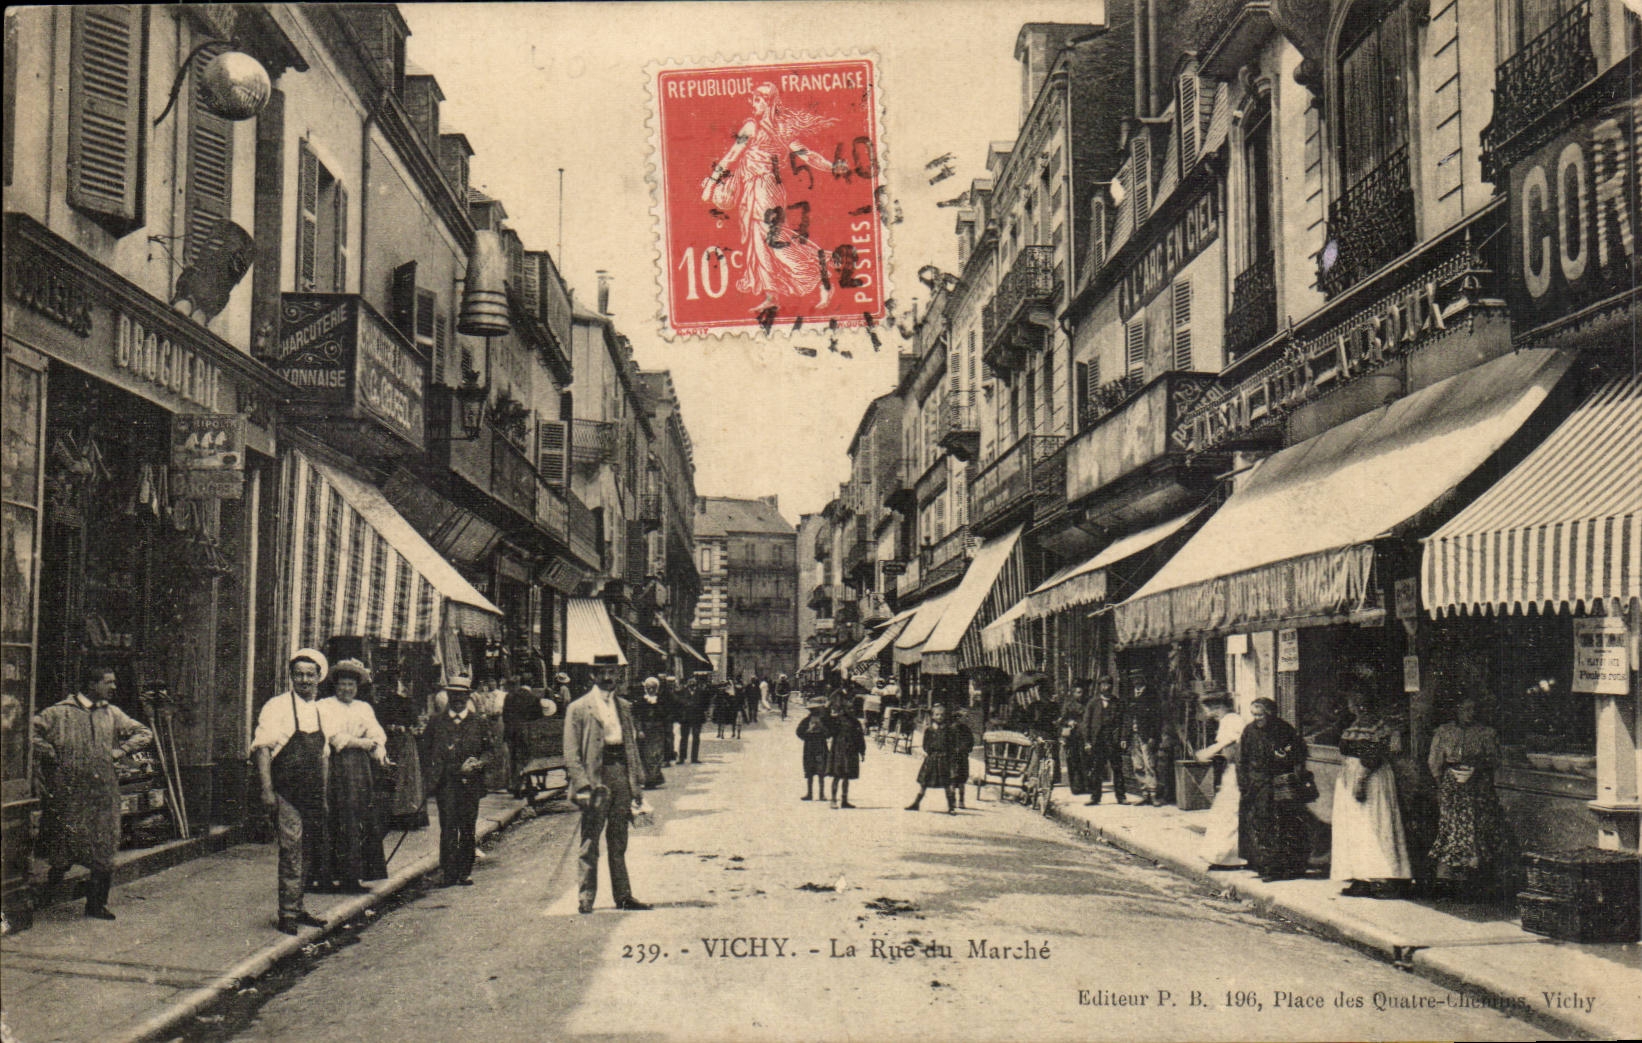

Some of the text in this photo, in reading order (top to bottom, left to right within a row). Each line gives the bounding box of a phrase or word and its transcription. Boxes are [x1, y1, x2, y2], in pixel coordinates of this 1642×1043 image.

[667, 71, 863, 99] REPUBLIQUE FRANÇAISE
[1166, 221, 1184, 274] EN
[1187, 191, 1217, 254] CIEL
[1522, 96, 1642, 298] COR
[855, 219, 873, 303] POSTES
[118, 313, 221, 414] DROGUERIE
